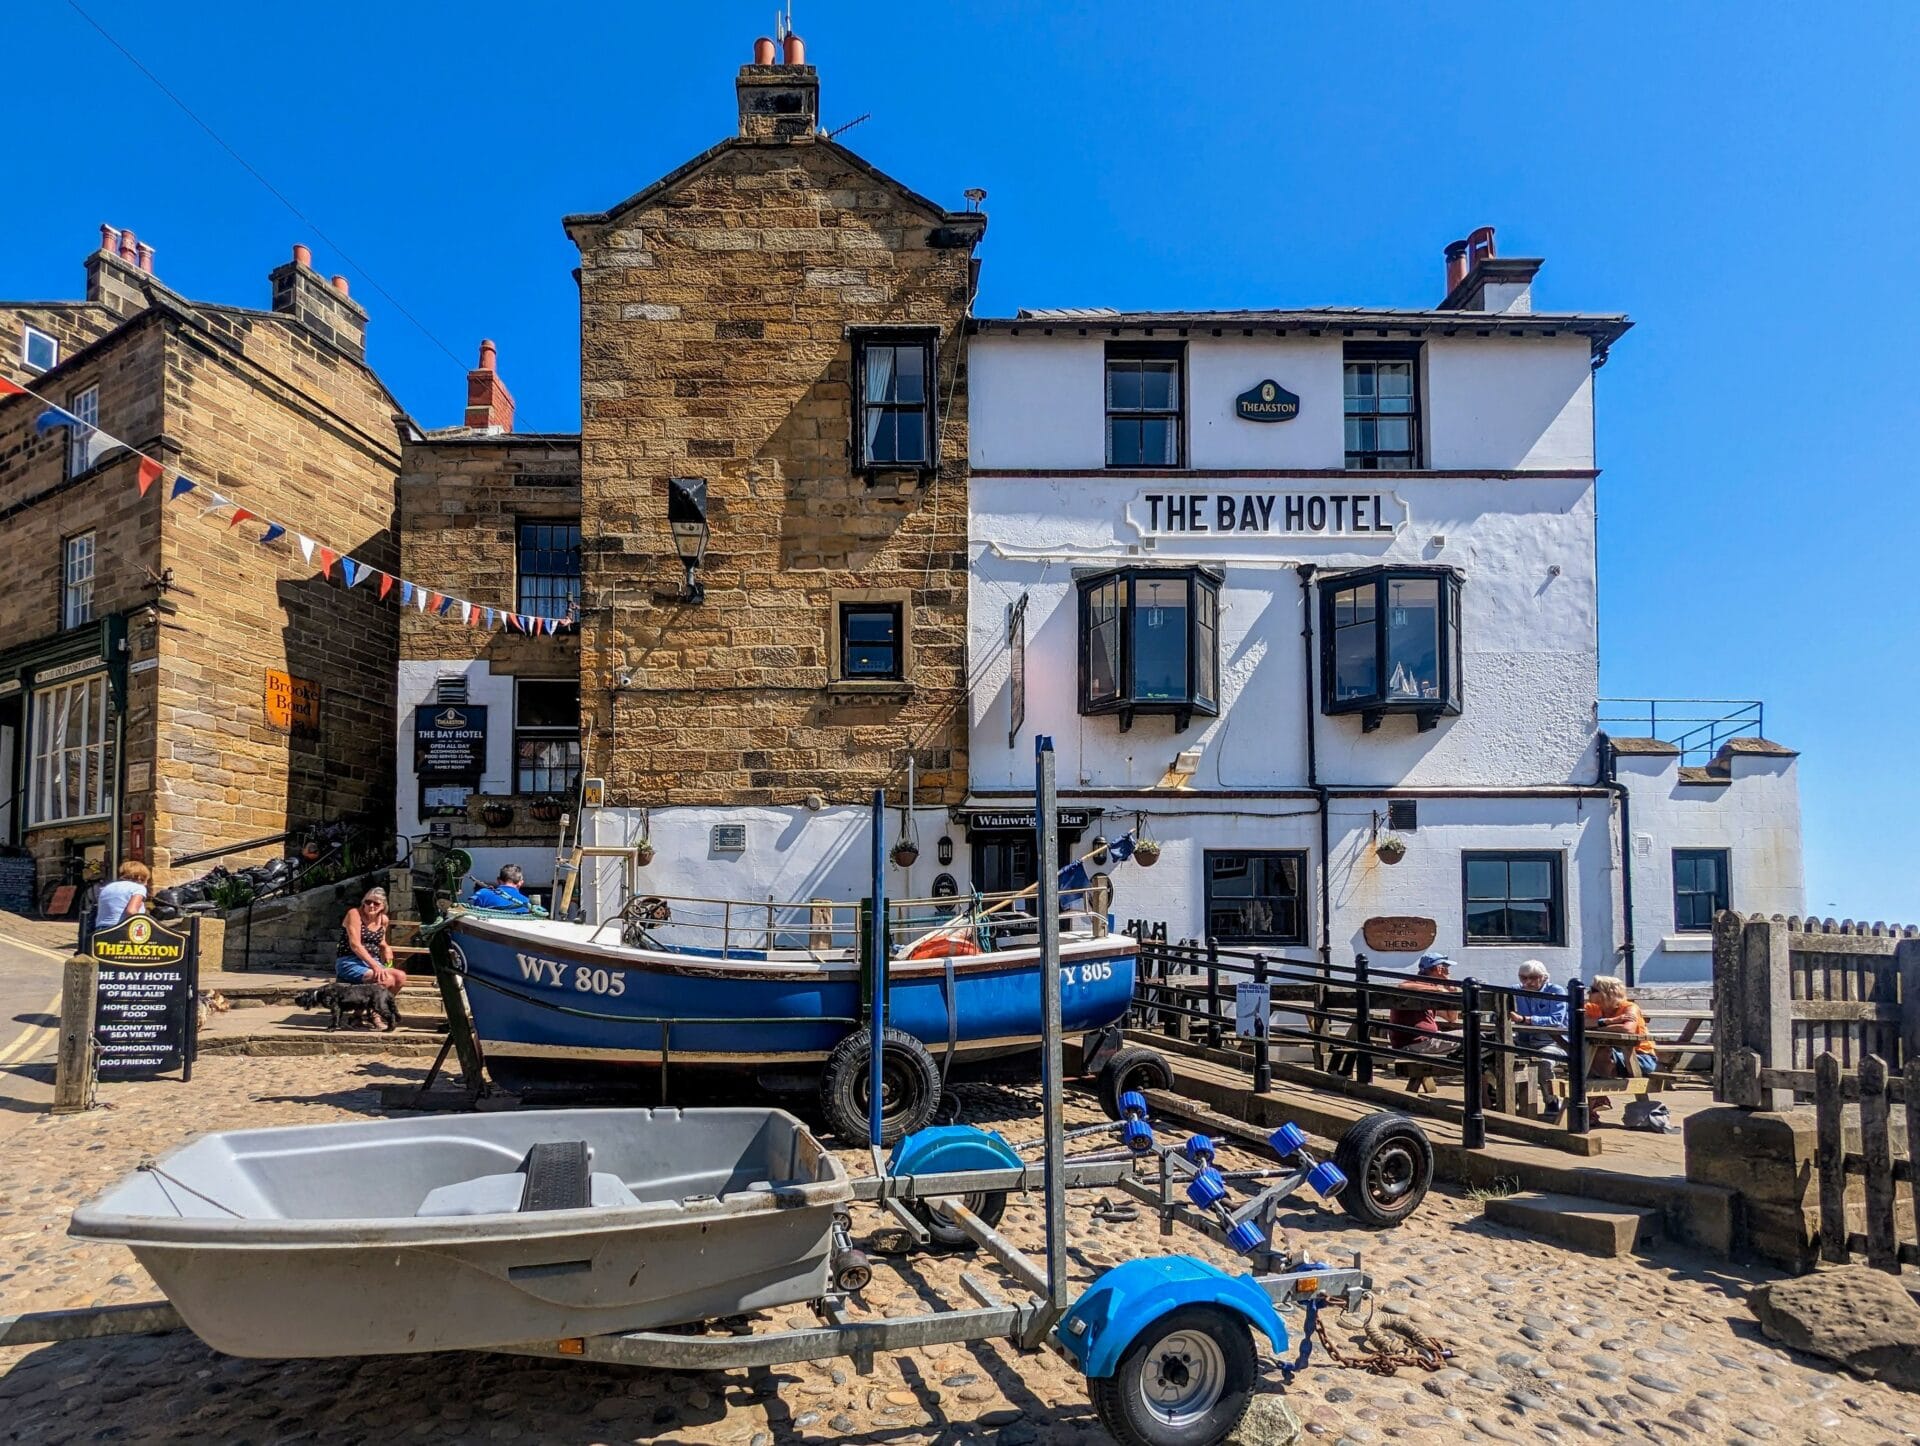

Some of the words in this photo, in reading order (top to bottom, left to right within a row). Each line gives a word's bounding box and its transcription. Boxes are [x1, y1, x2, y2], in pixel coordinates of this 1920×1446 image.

[1241, 401, 1296, 413] THEAKSTON
[1145, 495, 1208, 531] THE
[1217, 495, 1275, 531] BAY
[1286, 495, 1393, 531] HOTEL
[67, 663, 81, 674] POST
[269, 675, 320, 701] Brooke
[277, 694, 311, 715] Bond
[418, 730, 435, 738] THE
[437, 730, 454, 738] BAY
[456, 730, 483, 738] HOTEL
[1060, 814, 1083, 824] Bar
[96, 942, 179, 957] THEAKSTON
[1383, 940, 1400, 948] THE
[1401, 940, 1418, 948] END
[118, 971, 142, 981] BAY
[144, 972, 182, 981] HOTEL
[516, 952, 568, 987] WY
[574, 966, 626, 997] 805
[1081, 961, 1112, 983] 805
